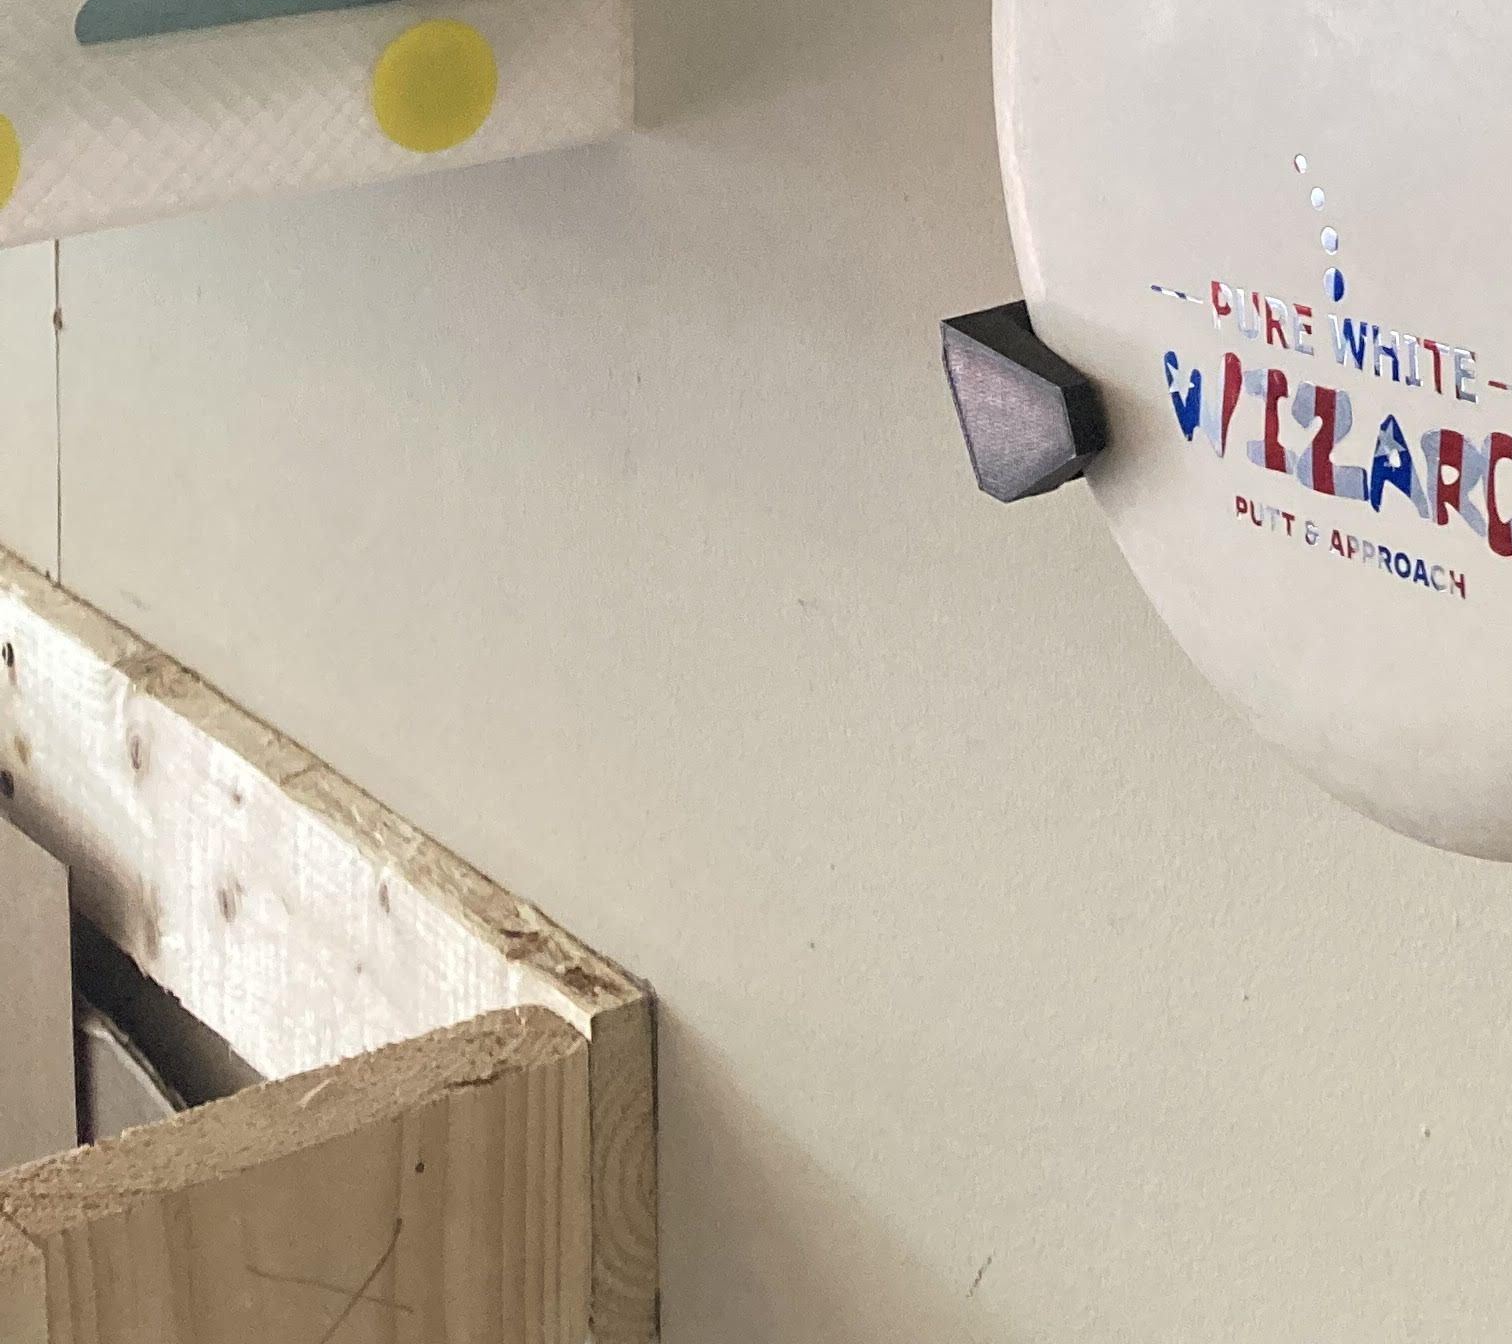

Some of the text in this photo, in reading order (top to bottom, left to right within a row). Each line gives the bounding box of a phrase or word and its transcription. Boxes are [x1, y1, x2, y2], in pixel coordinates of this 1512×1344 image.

[1210, 280, 1479, 404] PURE WHITE
[1235, 495, 1467, 599] PUTT & APPROACH
